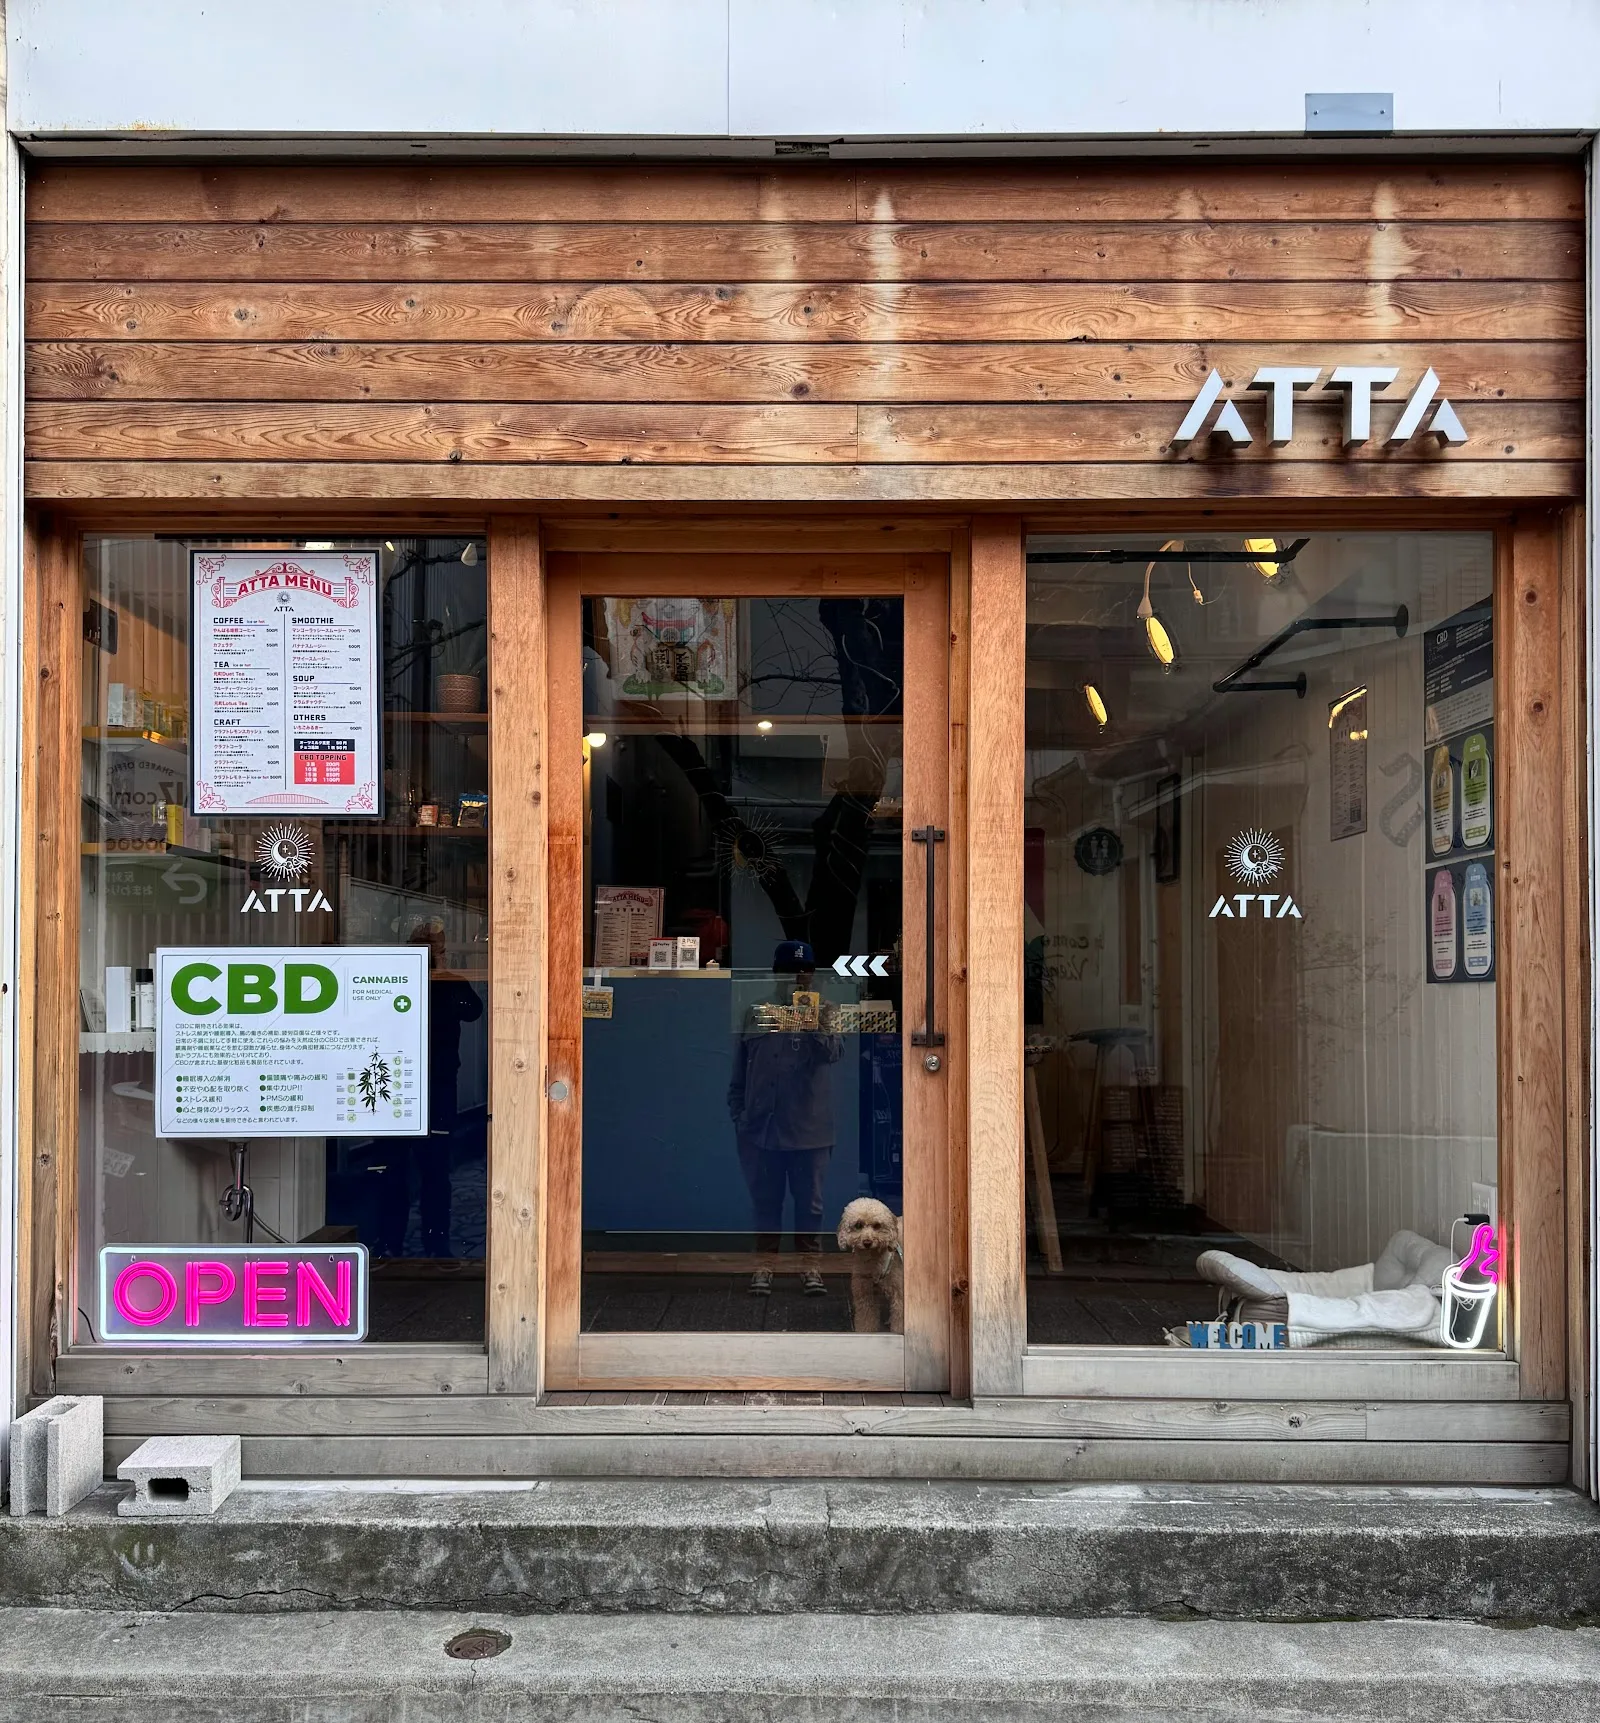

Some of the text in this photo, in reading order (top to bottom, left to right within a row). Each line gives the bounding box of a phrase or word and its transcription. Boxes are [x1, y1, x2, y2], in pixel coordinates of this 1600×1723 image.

[1170, 365, 1469, 447] ATTA
[238, 574, 332, 596] ATTA MENU
[213, 718, 241, 726] CRAFT
[240, 889, 334, 913] ATTA
[1208, 894, 1303, 918] ATTA
[170, 962, 339, 1016] CBD
[352, 975, 409, 984] CANNABIS
[113, 1261, 351, 1327] OPEN
[1186, 1320, 1289, 1349] WELCOME
